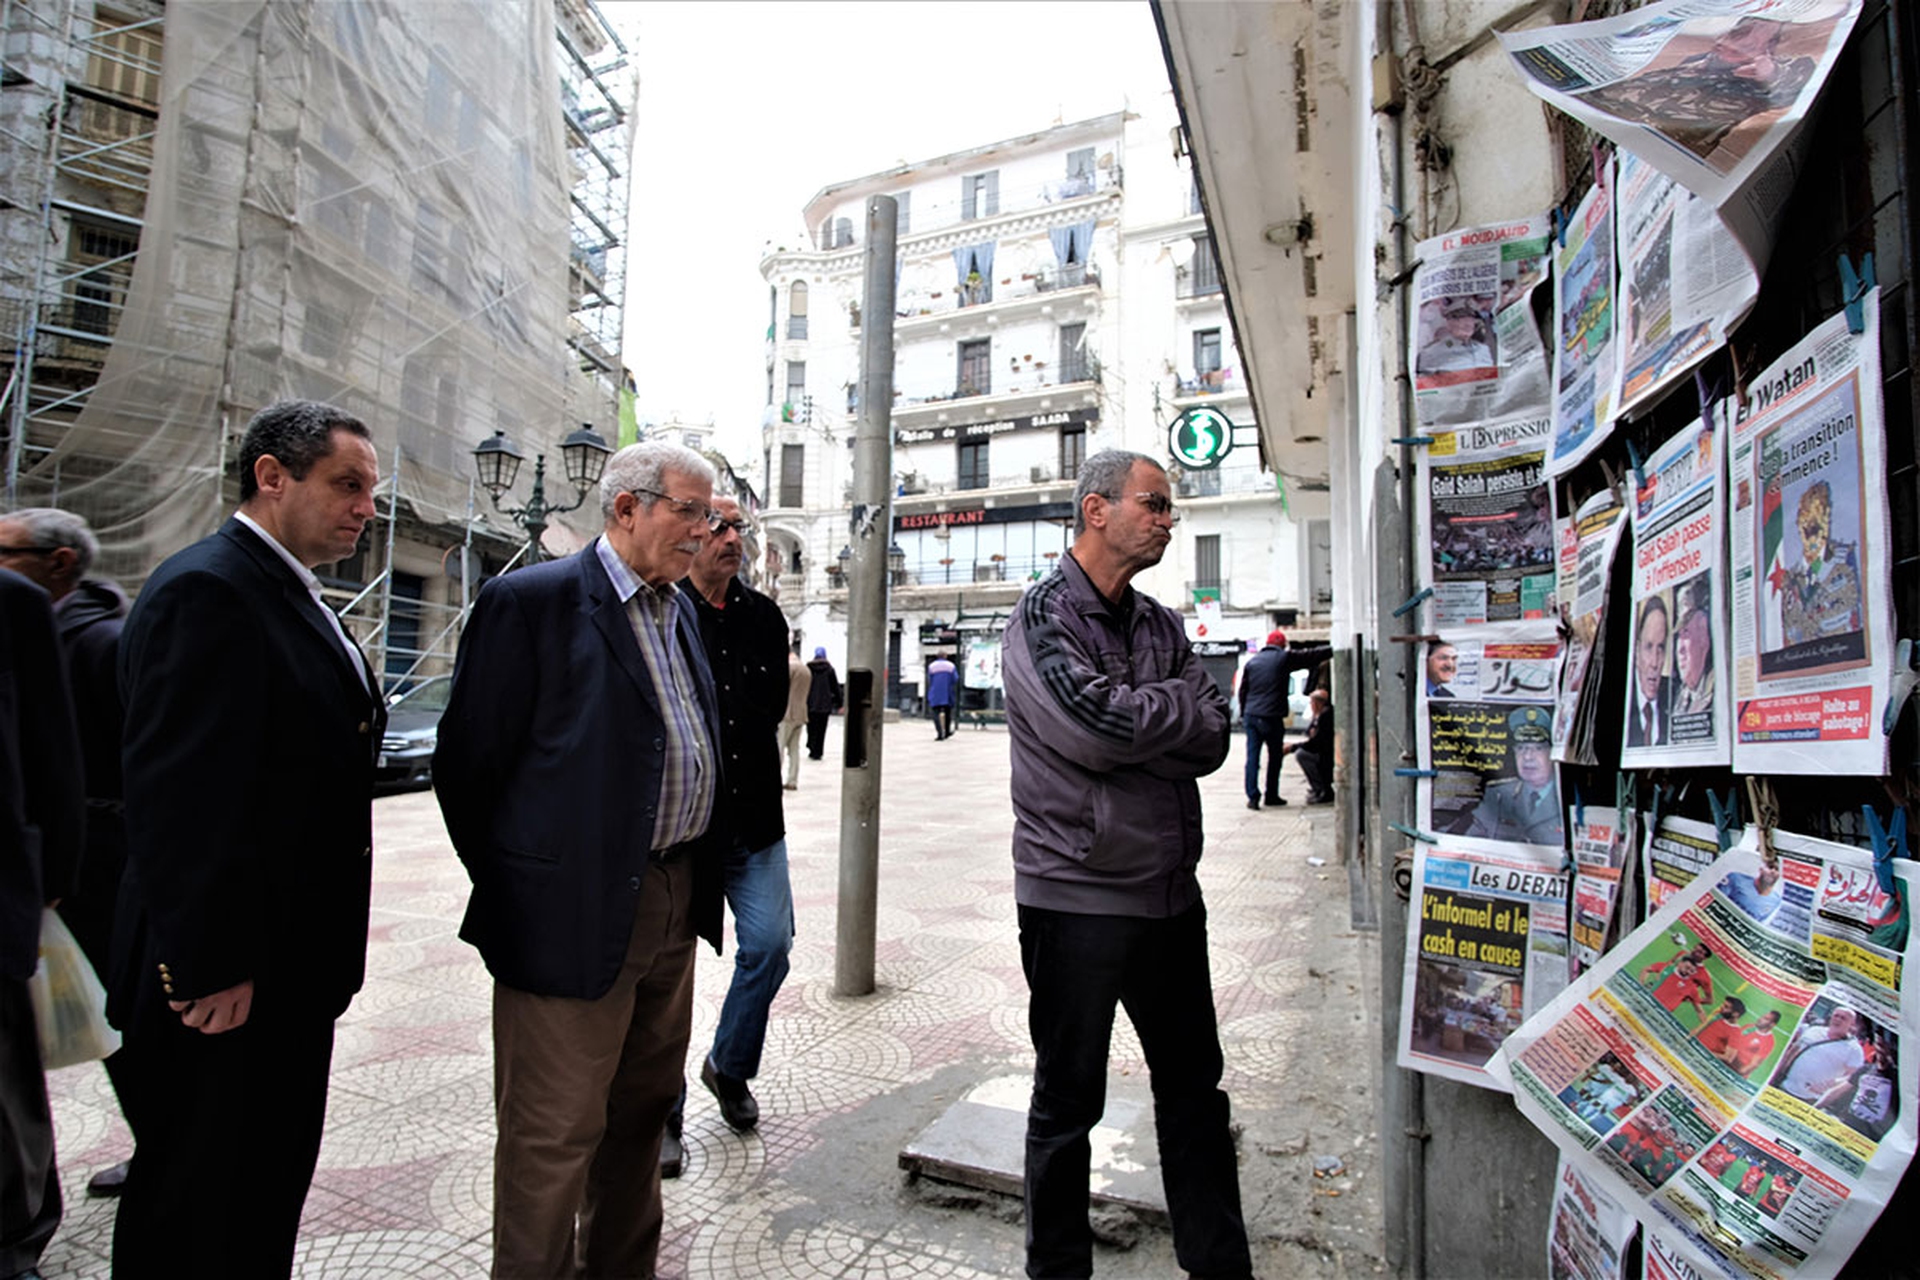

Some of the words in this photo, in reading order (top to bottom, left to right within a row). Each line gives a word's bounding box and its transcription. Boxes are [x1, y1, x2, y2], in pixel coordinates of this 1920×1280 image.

[1757, 356, 1815, 411] Watan
[1031, 412, 1070, 427] SAADA
[1791, 413, 1855, 462] transition
[901, 510, 986, 527] RESTAURANT
[1471, 866, 1500, 888] Les
[1506, 871, 1567, 899] DEBAT
[1422, 893, 1493, 929] L'informel
[1495, 909, 1511, 932] et
[1513, 907, 1528, 935] le
[1423, 928, 1456, 955] cash
[1458, 939, 1477, 959] en
[1480, 943, 1521, 967] cause
